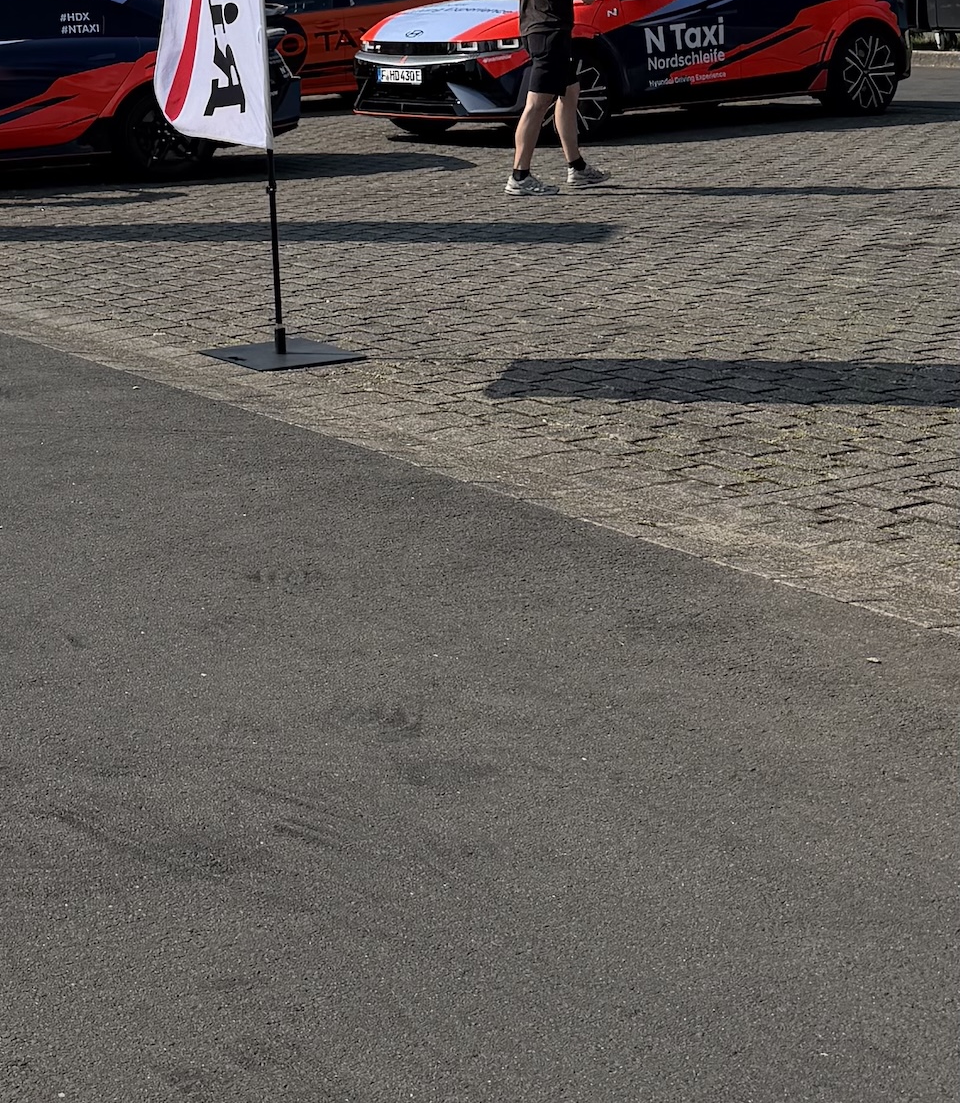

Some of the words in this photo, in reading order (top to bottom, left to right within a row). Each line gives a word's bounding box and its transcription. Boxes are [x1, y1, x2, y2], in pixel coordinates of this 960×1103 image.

[60, 12, 90, 22] #HDX
[61, 24, 100, 34] #NTAXI
[644, 25, 665, 54] N
[669, 16, 725, 50] Taxi
[647, 48, 726, 71] Nordschleife
